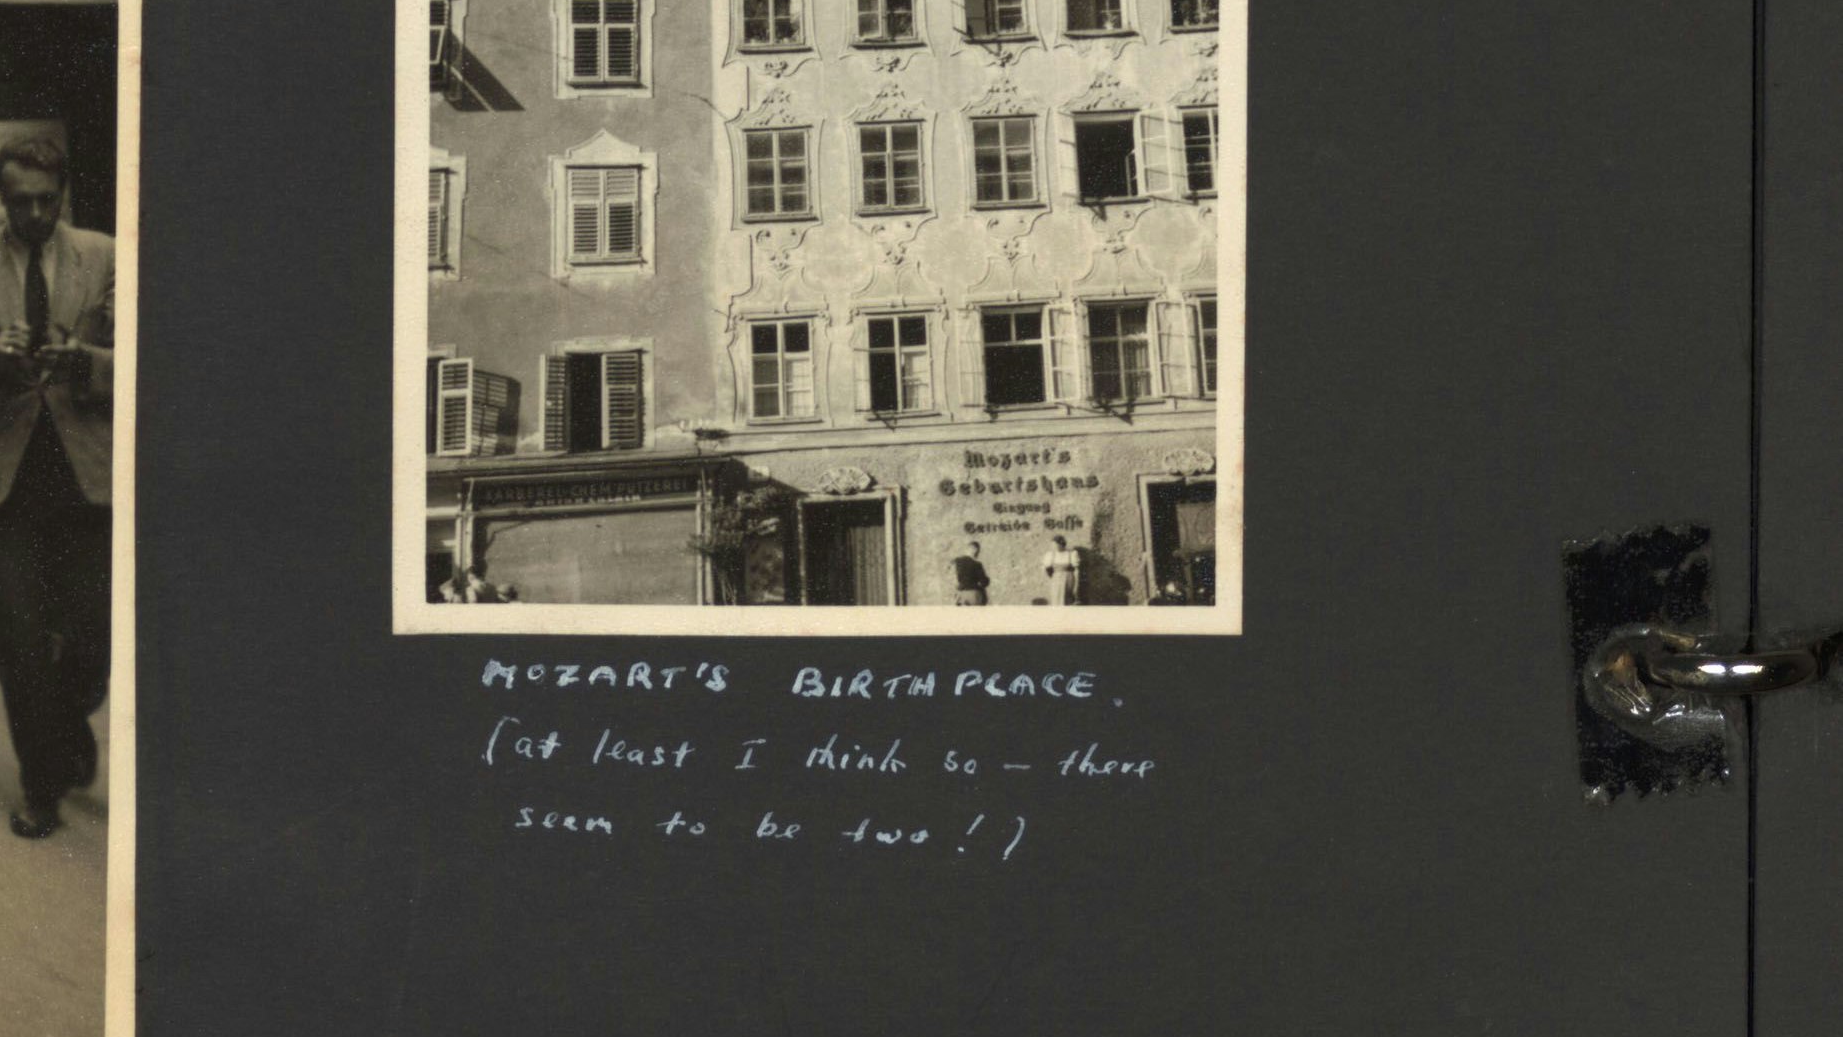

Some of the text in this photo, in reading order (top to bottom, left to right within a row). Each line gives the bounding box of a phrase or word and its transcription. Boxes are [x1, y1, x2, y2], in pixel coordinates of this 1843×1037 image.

[939, 475, 1100, 497] Geburtshaus
[482, 659, 729, 692] MOZART'S
[482, 716, 562, 765] (at
[592, 729, 697, 768] least
[735, 738, 767, 770] I
[806, 733, 907, 773] think
[943, 750, 978, 775] so
[1057, 742, 1156, 778] there
[515, 807, 613, 834] seem
[657, 811, 707, 836] to
[757, 811, 802, 838] be
